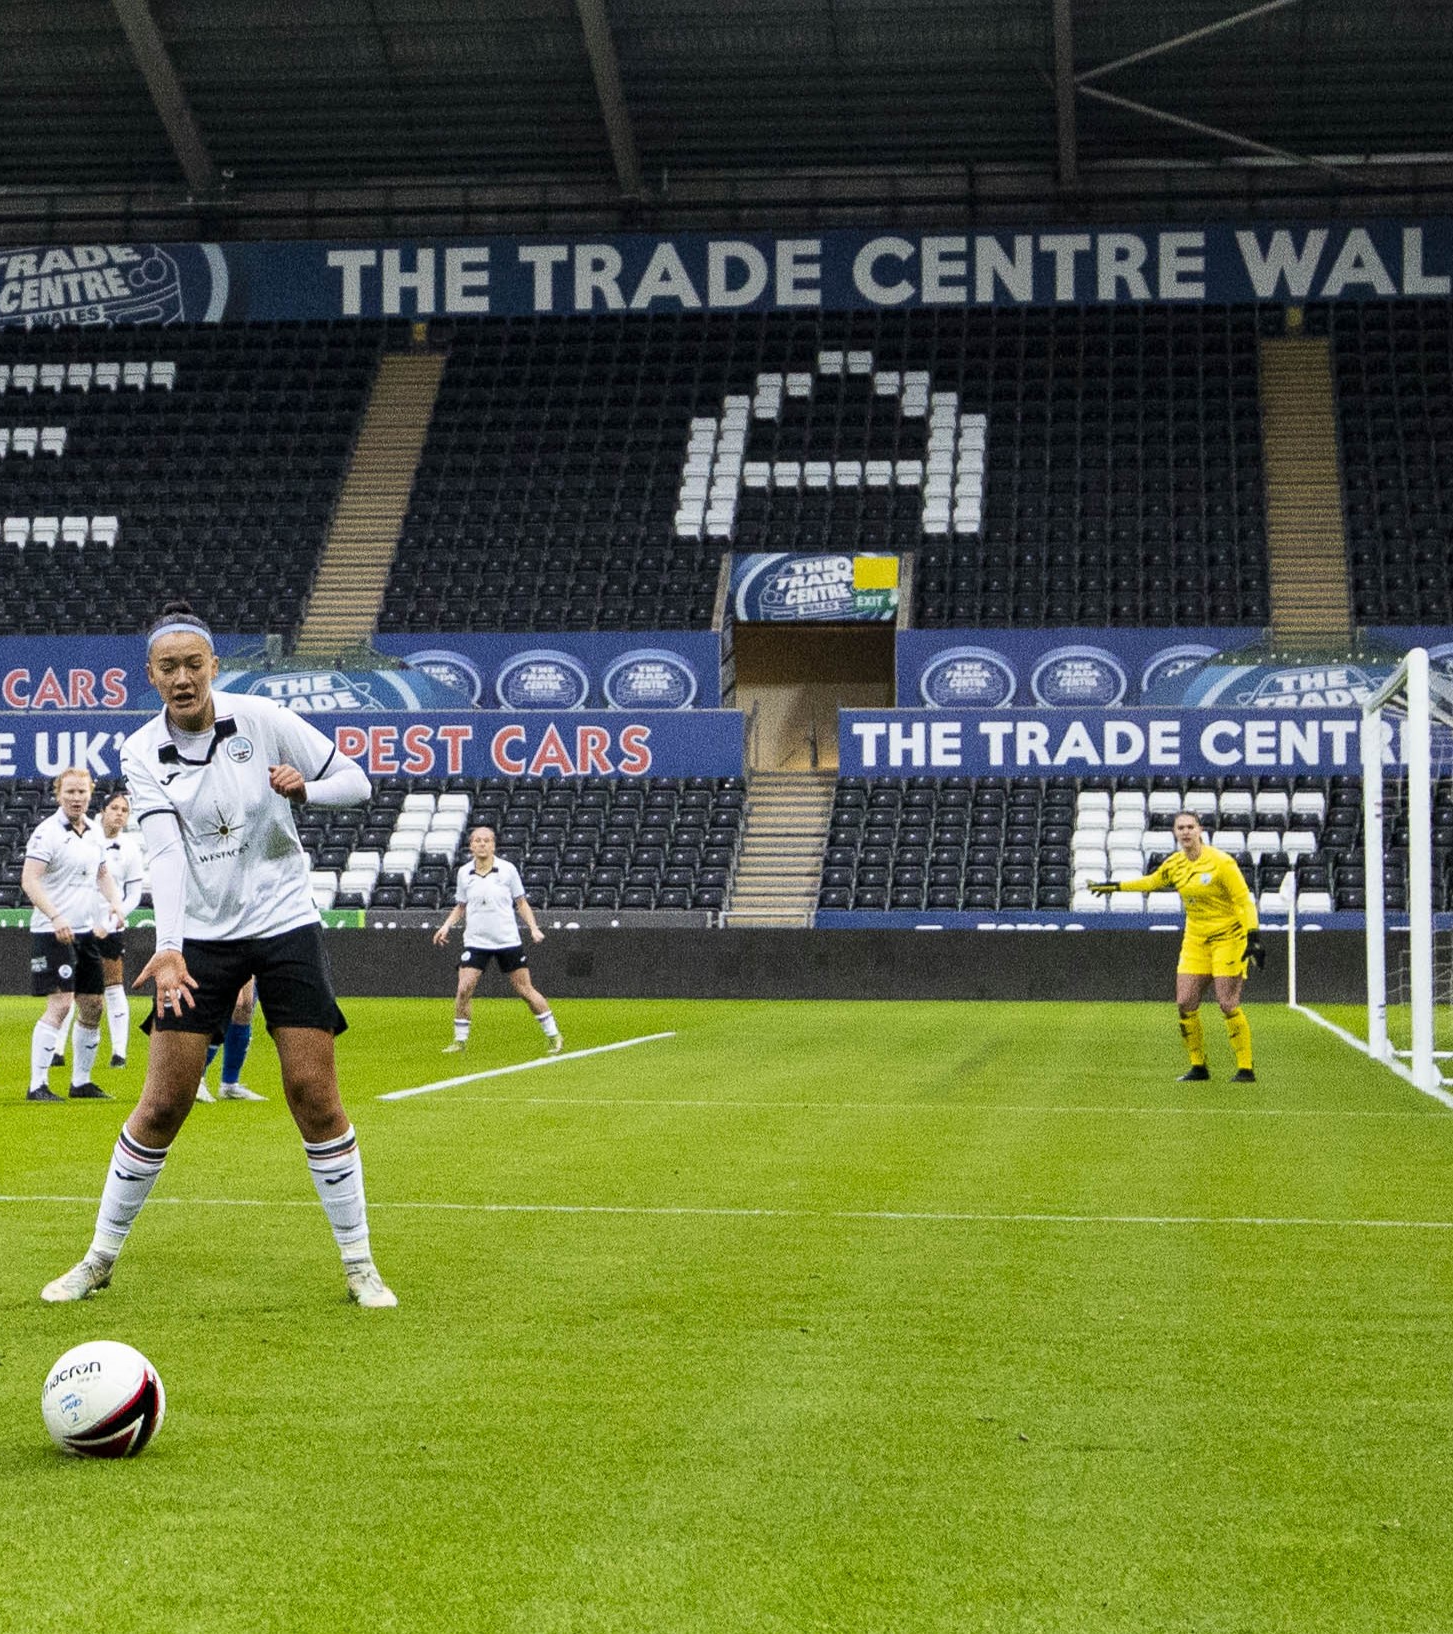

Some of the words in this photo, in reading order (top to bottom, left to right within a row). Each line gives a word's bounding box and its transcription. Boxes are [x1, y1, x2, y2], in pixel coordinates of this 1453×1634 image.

[327, 247, 489, 315] THE
[518, 239, 821, 311] TRADE
[852, 232, 1205, 305] CENTRE
[785, 583, 852, 605] CENTRE
[856, 595, 884, 607] EXIT
[2, 666, 128, 709] CARS
[265, 676, 333, 695] THE
[1276, 670, 1347, 691] THE
[490, 722, 653, 777] CARS
[852, 721, 962, 767] THE
[978, 720, 1181, 766] TRADE
[1199, 719, 1410, 767] CENTR
